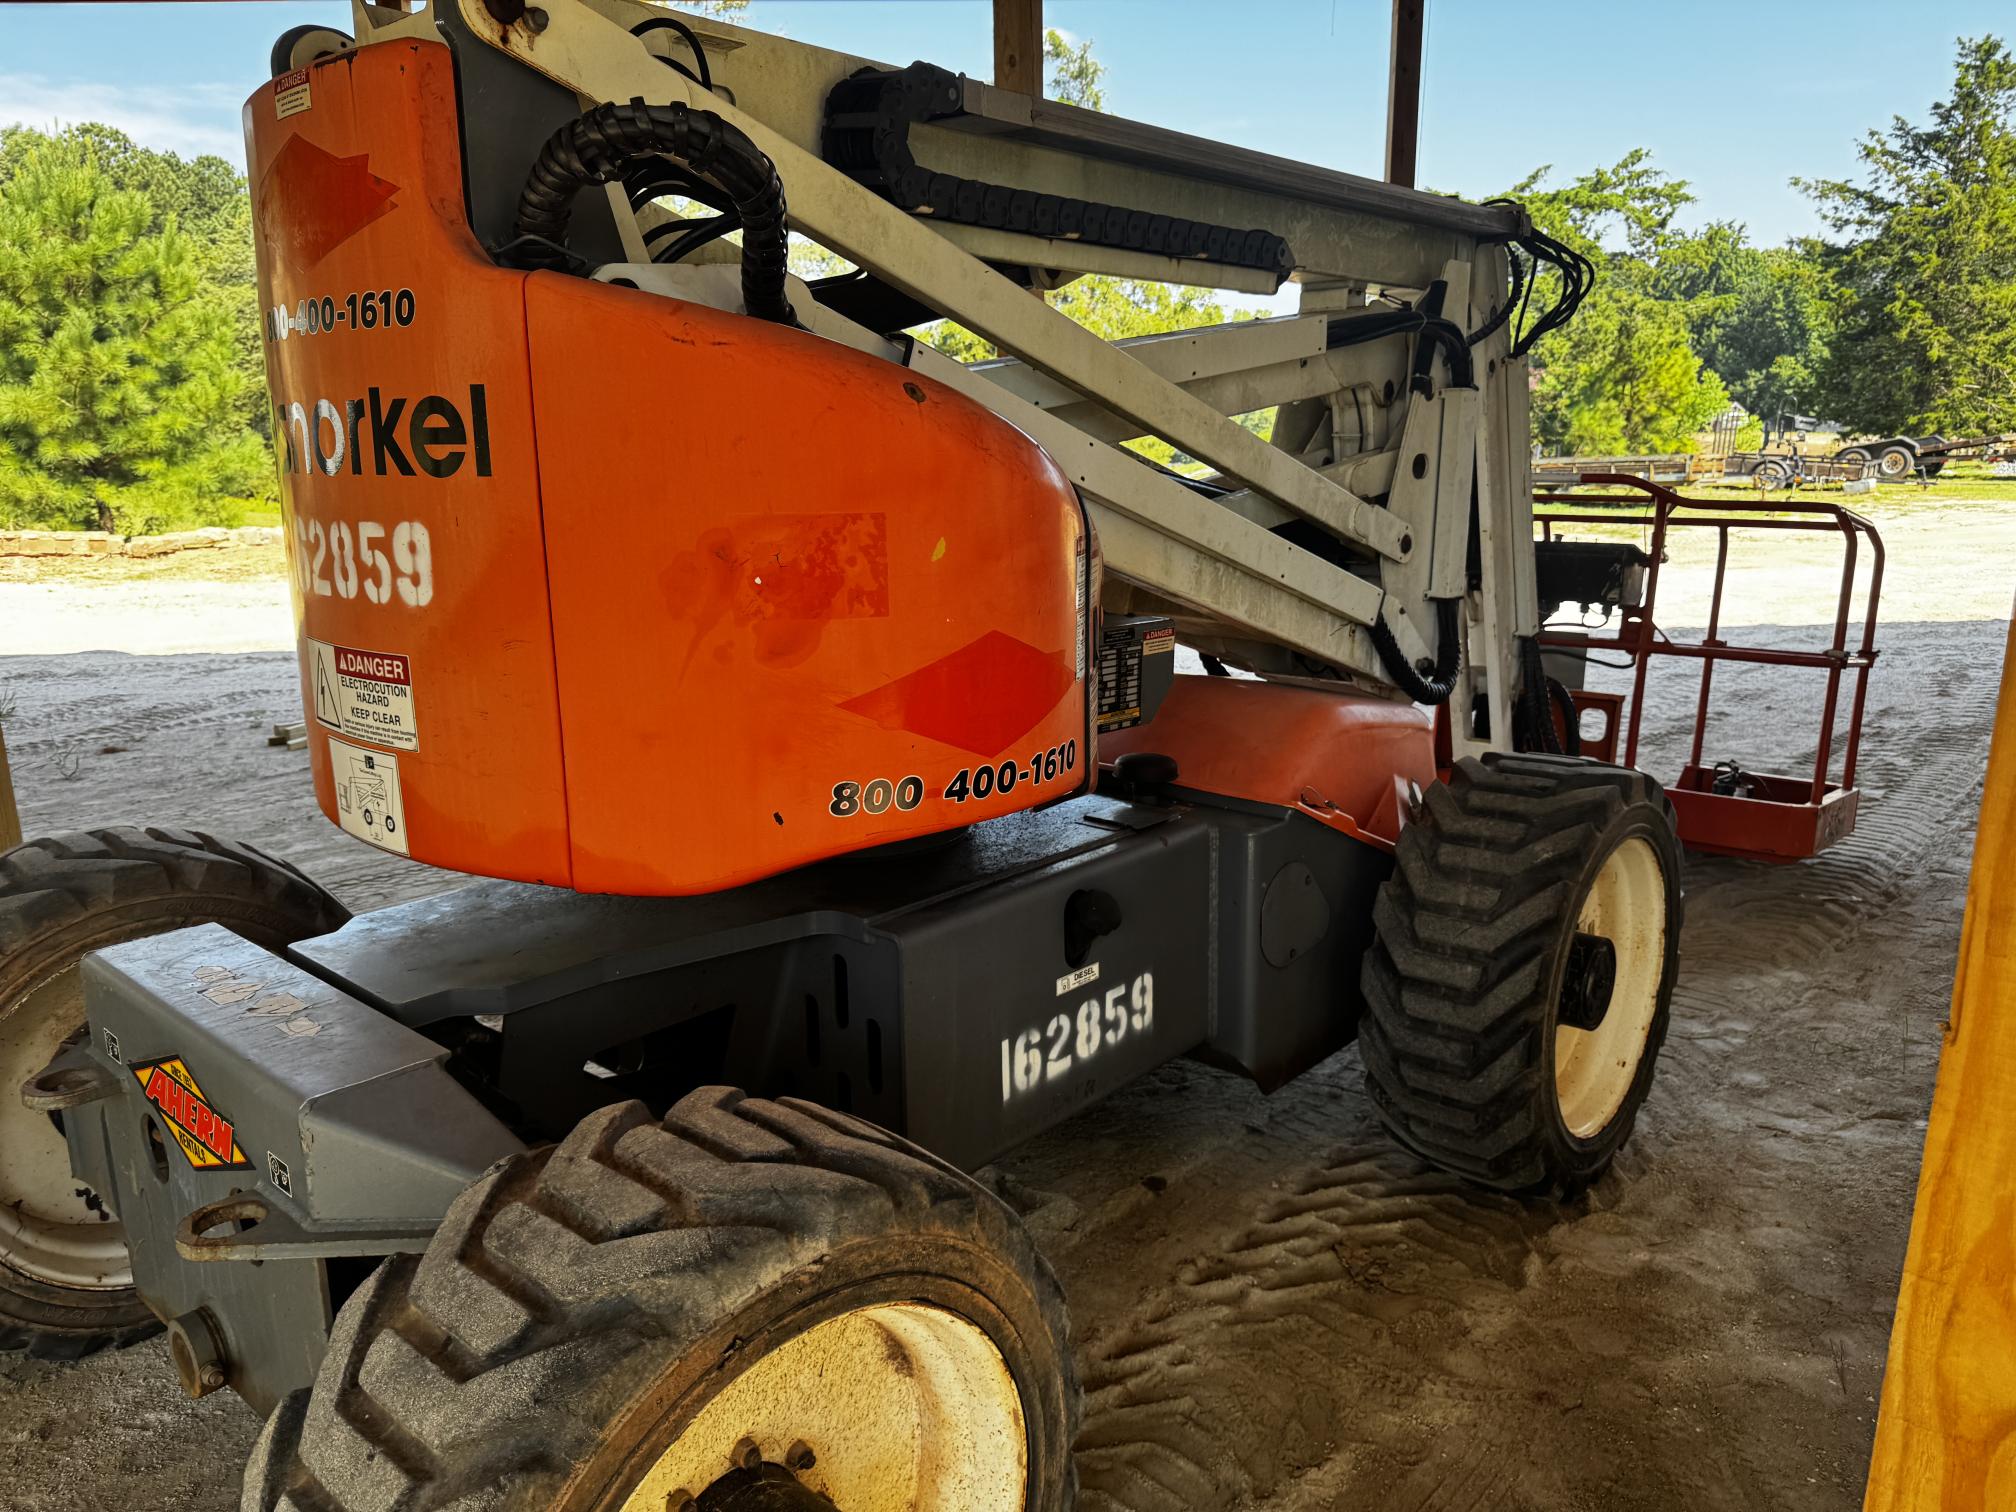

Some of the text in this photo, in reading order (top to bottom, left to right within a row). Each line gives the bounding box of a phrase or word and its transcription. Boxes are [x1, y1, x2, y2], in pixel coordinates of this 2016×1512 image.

[282, 71, 306, 90] DANGER
[1150, 628, 1173, 639] DANGER
[347, 653, 404, 680] DANGER
[341, 676, 407, 698] ELECTROCUTION
[356, 691, 390, 707] HAZARD
[351, 706, 401, 727] KEEP CLEAR
[828, 738, 1076, 817] 800 400-1610
[1073, 967, 1095, 981] DIESEL
[1001, 972, 1154, 1103] 162859
[146, 1067, 234, 1163] AHERN
[178, 1129, 206, 1164] RENTALS
